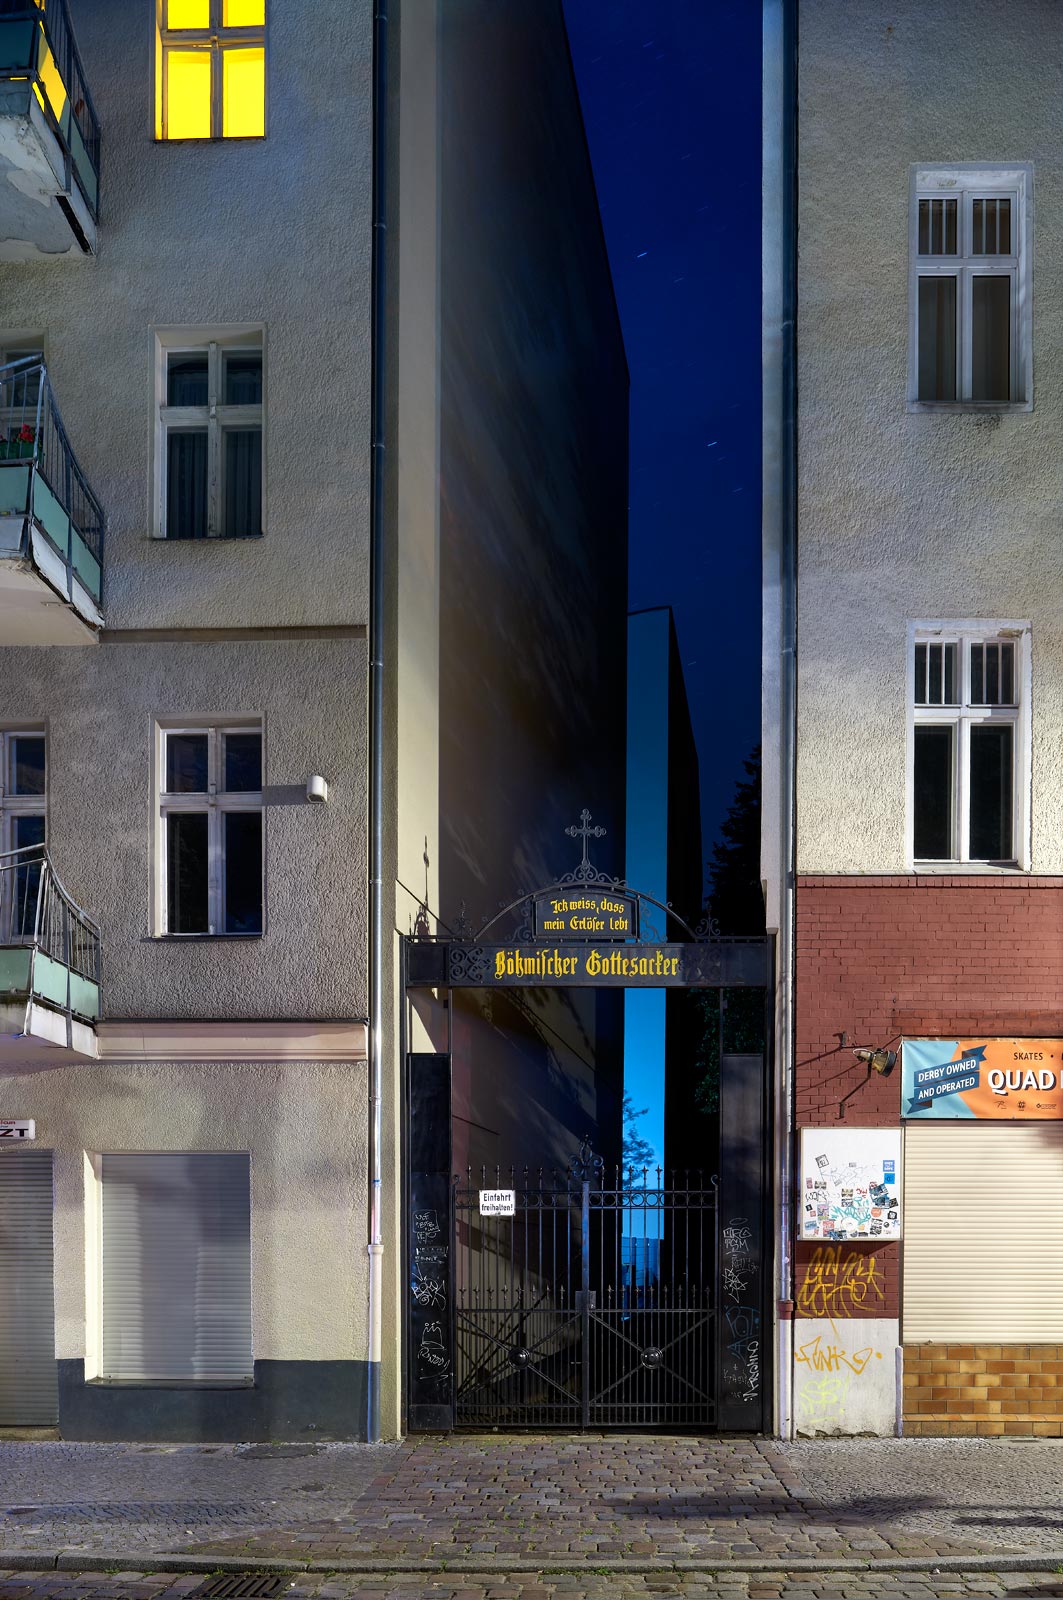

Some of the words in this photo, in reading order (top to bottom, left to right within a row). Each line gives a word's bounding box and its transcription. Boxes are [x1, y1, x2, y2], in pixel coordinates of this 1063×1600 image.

[550, 899, 568, 914] Ich
[600, 897, 625, 913] dass
[544, 918, 565, 930] mein
[609, 917, 628, 931] lebt
[585, 949, 679, 977] Gottesacker
[1013, 1052, 1044, 1061] SKATES
[918, 1067, 945, 1083] DERBY
[946, 1058, 976, 1076] OWNED
[918, 1086, 935, 1100] AND
[937, 1076, 976, 1095] OPERATED
[987, 1069, 1057, 1096] QUAD
[483, 1193, 511, 1202] Einfahrt
[481, 1203, 513, 1212] freihalten!
